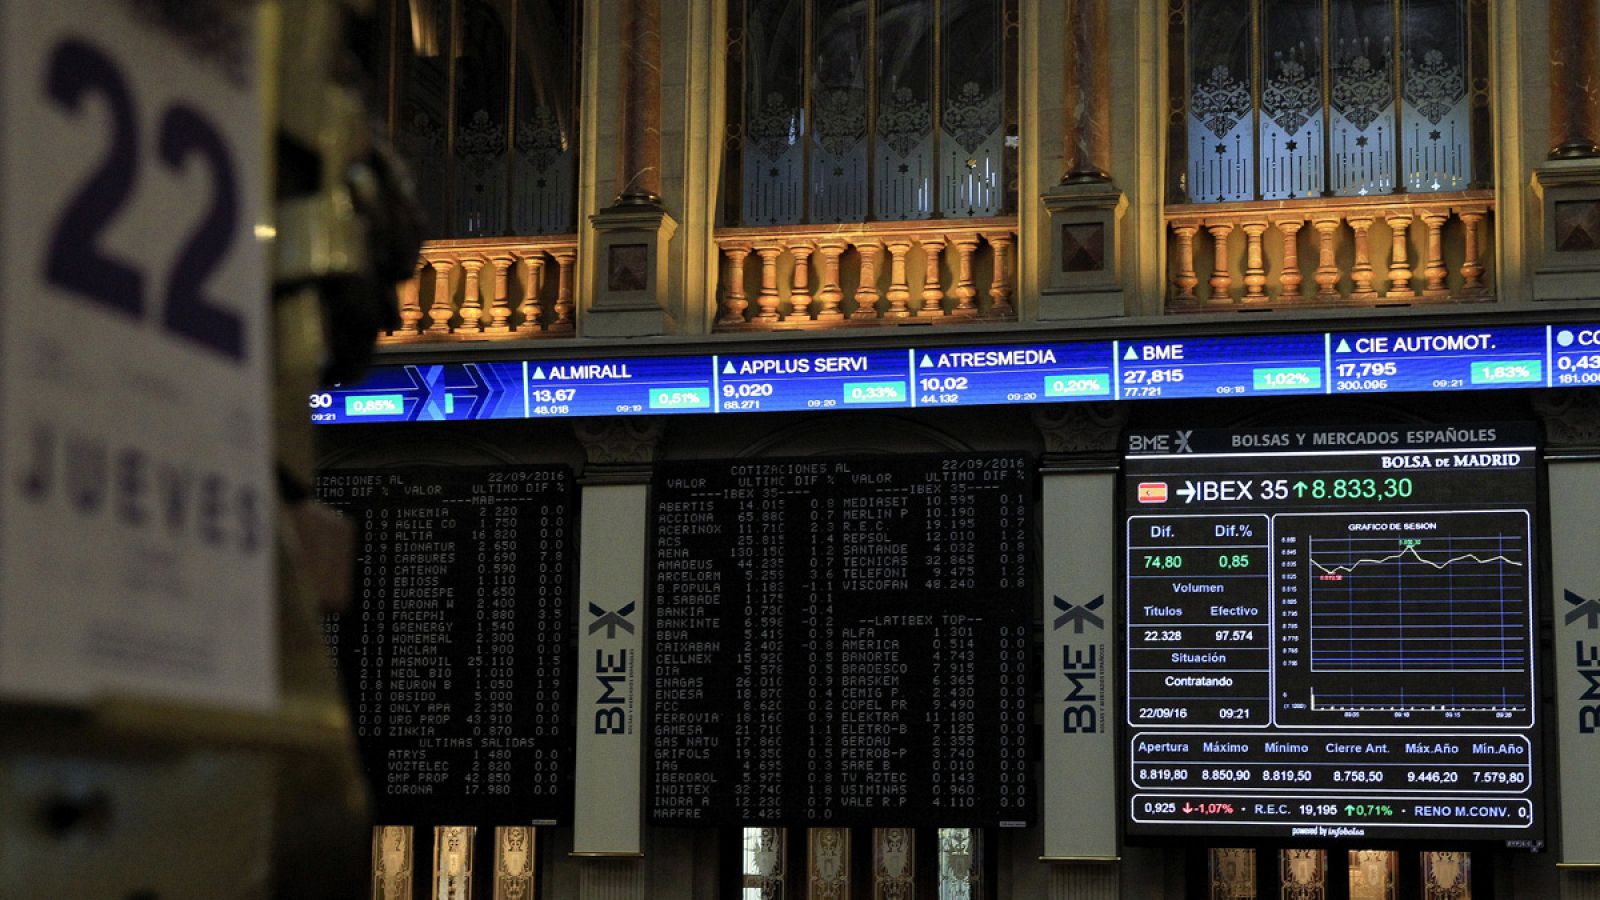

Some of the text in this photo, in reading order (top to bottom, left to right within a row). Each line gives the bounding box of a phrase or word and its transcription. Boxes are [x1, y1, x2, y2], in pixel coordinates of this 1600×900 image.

[44, 34, 246, 362] 22
[1355, 333, 1496, 353] CIE AUTOMOT.
[1142, 344, 1184, 361] BME
[937, 349, 1056, 368] ATRESMEDIA
[740, 356, 868, 375] APPLUS SERVI
[1336, 361, 1397, 379] 17,795
[548, 364, 632, 380] ALMIRALL
[1481, 364, 1529, 379] 1,63%
[1123, 369, 1184, 386] 27,815
[1263, 371, 1310, 386] 1,02%
[1432, 378, 1464, 388] 09:21
[919, 377, 968, 393] 10,02
[1053, 378, 1100, 393] 0,20%
[533, 389, 576, 404] 13,67
[723, 383, 773, 399] 9,020
[852, 385, 897, 400] 0,33%
[1123, 387, 1161, 397] 77.721
[658, 392, 700, 406] 0,51%
[920, 394, 958, 405] 44.132
[1007, 392, 1037, 402] 09:20
[353, 400, 396, 413] 0,85%
[723, 400, 760, 410] 68.271
[807, 399, 836, 409] 09:20
[1129, 427, 1497, 450] BME BOLSAS Y MERCADOS ESPAÑOLES
[1382, 456, 1431, 469] BOLSA
[1454, 453, 1520, 467] MADRID
[731, 458, 1025, 476] COTIZACIONES AL 22/09/2016
[488, 471, 564, 483] 22/09/2016
[852, 471, 1008, 484] VALOR ULTIMO DIF
[667, 478, 707, 489] VALOR
[404, 484, 522, 495] VALOR ULTIMO
[1197, 478, 1413, 501] IBEX 35 8.833,30
[659, 501, 714, 512] ABERTIS
[844, 496, 908, 507] MEDIASET
[658, 513, 714, 524] ACCIONA
[658, 525, 722, 536] ACERINOX
[1151, 525, 1252, 538] Dif. Dif.%
[658, 537, 681, 547] ACS
[844, 532, 892, 542] REPSOL
[658, 548, 689, 558] AENA
[843, 544, 908, 555] SANTANDE
[657, 560, 713, 570] AMADEUS
[844, 556, 908, 566] TECNICAS
[1144, 555, 1249, 569] 74,80 0,85
[657, 571, 721, 582] ARCELORM
[844, 568, 907, 578] TELEFONI
[843, 580, 908, 590] VISCOFAN
[1172, 583, 1224, 593] Volumen
[657, 607, 705, 617] BANKIA
[1210, 605, 1258, 616] Efectivo
[656, 631, 688, 641] BBVA
[1144, 631, 1253, 641] 22.328 97.574
[656, 642, 720, 653] CAIXABAN
[843, 640, 900, 650] AMERICA
[656, 654, 712, 664] CELLNEX
[842, 652, 899, 662] BANORTE
[1171, 652, 1226, 663] Situación
[655, 666, 680, 676] DIA
[842, 664, 908, 674] BRADESCO
[655, 678, 704, 688] ENAGAS
[842, 676, 899, 686] BRASKEM
[1165, 676, 1233, 687] Contratando
[595, 649, 626, 735] BME
[1064, 644, 1097, 733] BME
[655, 690, 704, 700] ENDESA
[655, 702, 679, 711] FCC
[655, 713, 719, 723] FERROVIA
[842, 712, 899, 722] ELEKTRA
[1139, 708, 1250, 719] 22/09/16 09:21
[389, 726, 435, 736] ZINKIA
[655, 725, 703, 736] GAMESA
[420, 738, 535, 748] ULTIMAS SALIDAS
[841, 736, 890, 746] GERDAU
[1138, 741, 1189, 755] Apertura
[1203, 740, 1249, 753] Máximo
[1325, 742, 1361, 753] Cierre
[1365, 742, 1391, 754] Ant.
[388, 749, 426, 759] ATRYS
[654, 749, 710, 759] GRIFOLS
[655, 761, 678, 771] IAG
[655, 773, 718, 783] IBERDROL
[1139, 768, 1524, 786] 8.819,80 8.850,90 8.819,50 8.758,50 9.446,20 7.579,80
[386, 785, 433, 795] CORONA
[655, 785, 710, 795] INDITEX
[841, 785, 907, 795] USIMINAS
[653, 808, 702, 818] MAPFRE
[1144, 801, 1176, 815] 0,925
[1193, 802, 1234, 815] -1,07%
[1255, 803, 1291, 815] R.E.C.
[1299, 803, 1338, 818] 19,195
[1356, 804, 1393, 818] 0,71%
[1414, 805, 1452, 818] RENO
[1455, 806, 1510, 818] M.CONV.
[1292, 825, 1317, 836] powered
[1319, 826, 1327, 836] by
